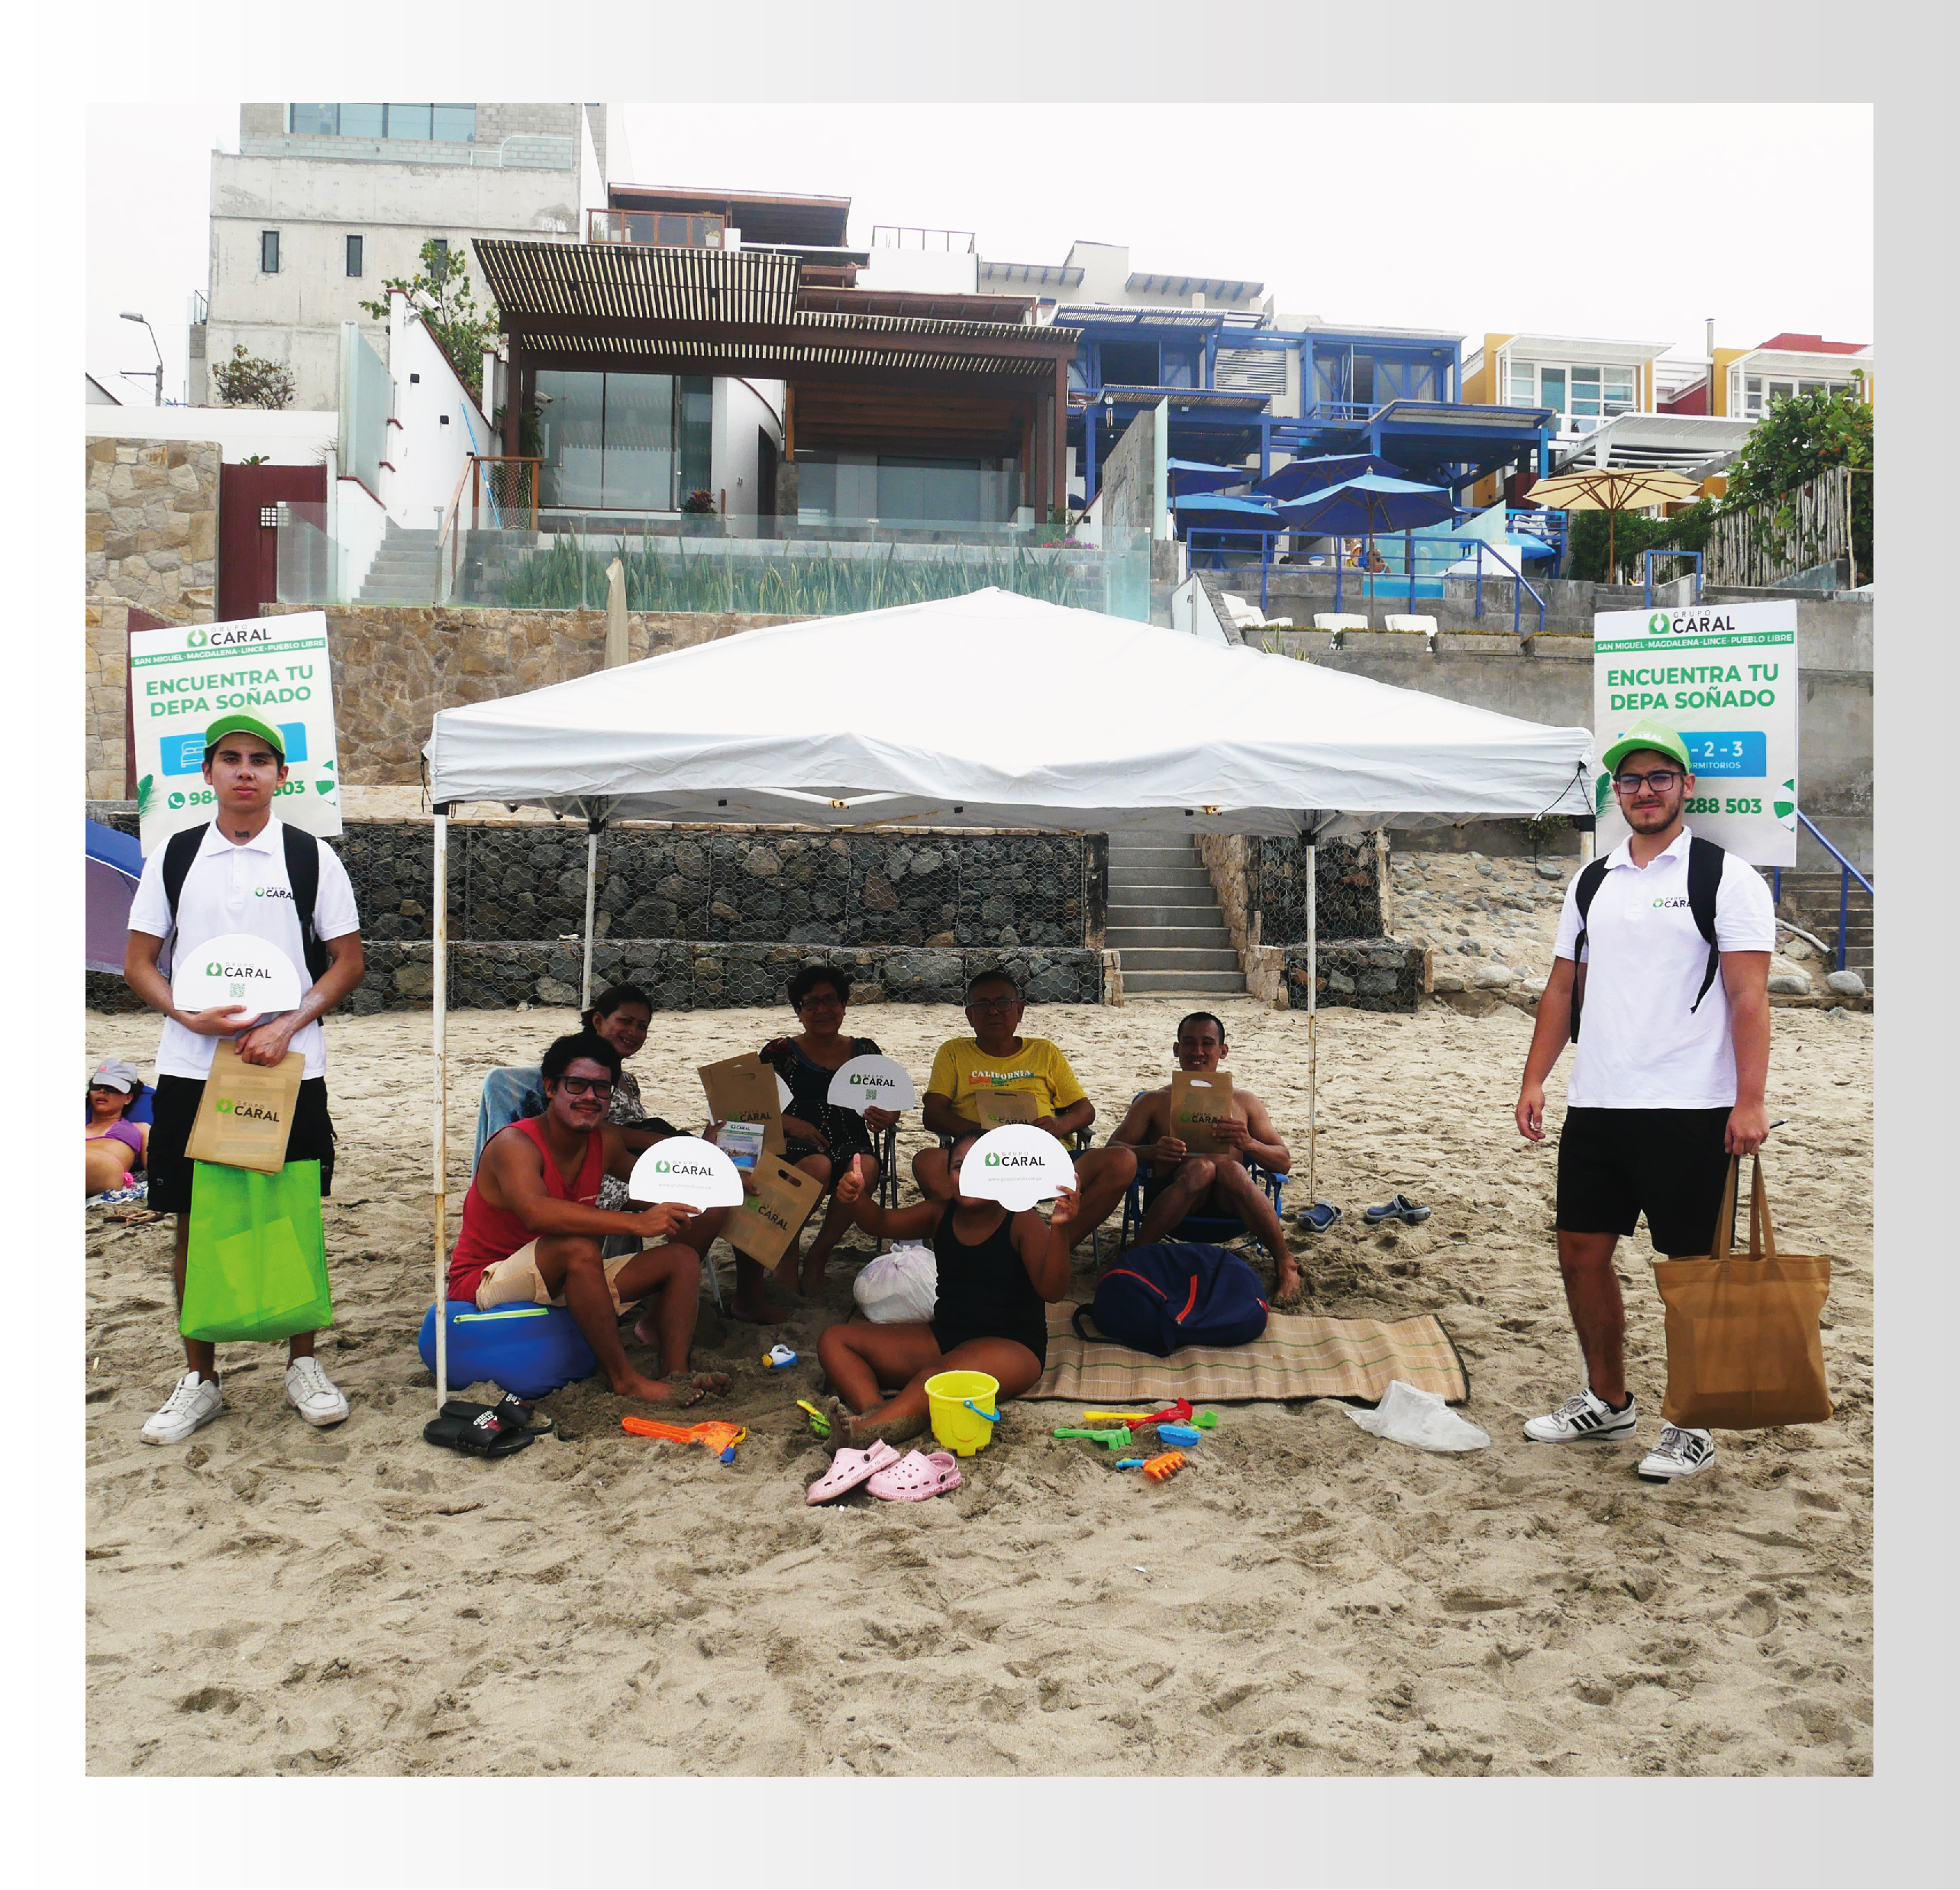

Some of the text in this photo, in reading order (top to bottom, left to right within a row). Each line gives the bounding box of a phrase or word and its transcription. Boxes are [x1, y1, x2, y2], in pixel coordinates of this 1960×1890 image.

[1673, 609, 1710, 618] GRUPO
[211, 624, 247, 633] GRUPO
[1672, 615, 1736, 634] CARAL
[210, 628, 272, 646] CARAL
[1768, 634, 1792, 642] LIBRE
[301, 639, 325, 648] LIBRE
[146, 664, 314, 696] ENCUENTRA TU
[1607, 664, 1779, 687] ENCUENTRA TU
[150, 686, 312, 717] DEPA SOÑADO
[1610, 686, 1775, 711] DEPA SOÑADO
[1703, 741, 1714, 758] 2
[1732, 741, 1744, 758] 3
[1684, 797, 1762, 814] 288 503
[266, 890, 295, 900] CARA
[224, 967, 272, 978] CARAL
[971, 1070, 1031, 1080] CALIFORNIA
[862, 1077, 896, 1087] CARAL
[237, 1100, 265, 1110] GRUPO
[234, 1106, 280, 1123] CARAL
[739, 1112, 773, 1123] CARAL
[1001, 1156, 1046, 1167] CARAL
[672, 1165, 715, 1177] CARAL
[757, 1206, 788, 1231] CARAL
